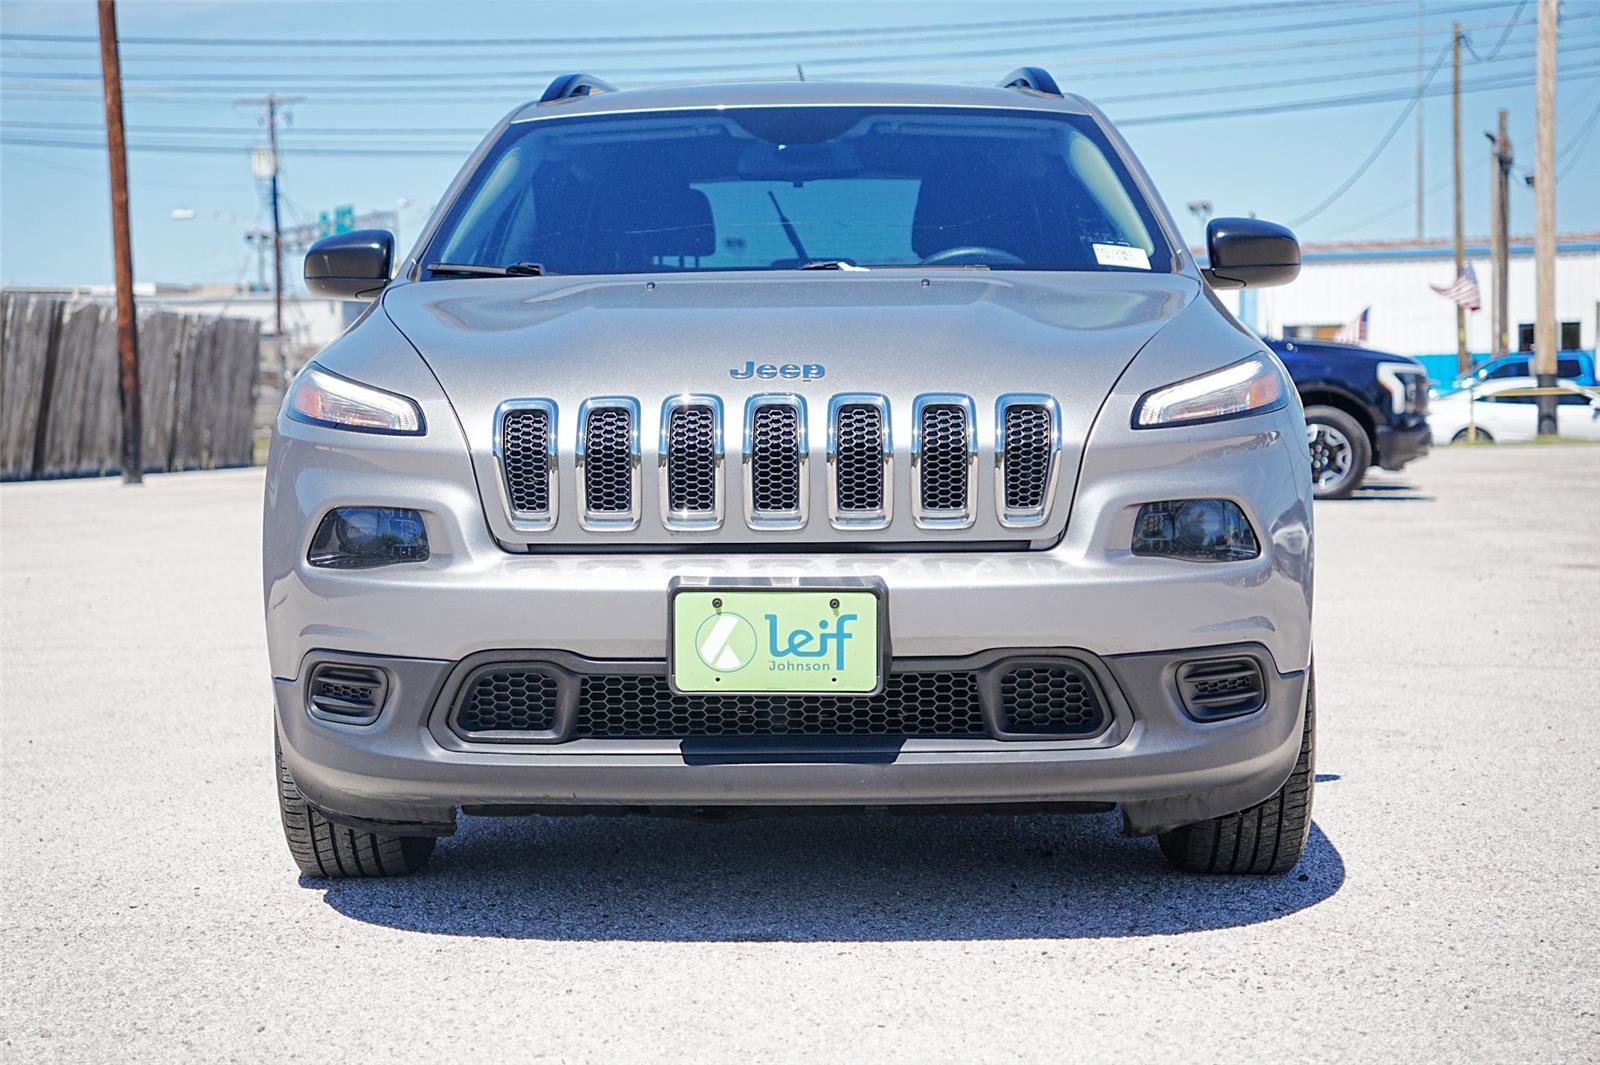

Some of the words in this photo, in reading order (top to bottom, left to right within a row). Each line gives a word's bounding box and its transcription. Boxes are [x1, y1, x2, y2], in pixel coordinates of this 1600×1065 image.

[729, 361, 826, 382] Jeep
[764, 613, 858, 671] leif
[768, 660, 830, 671] Johnson
